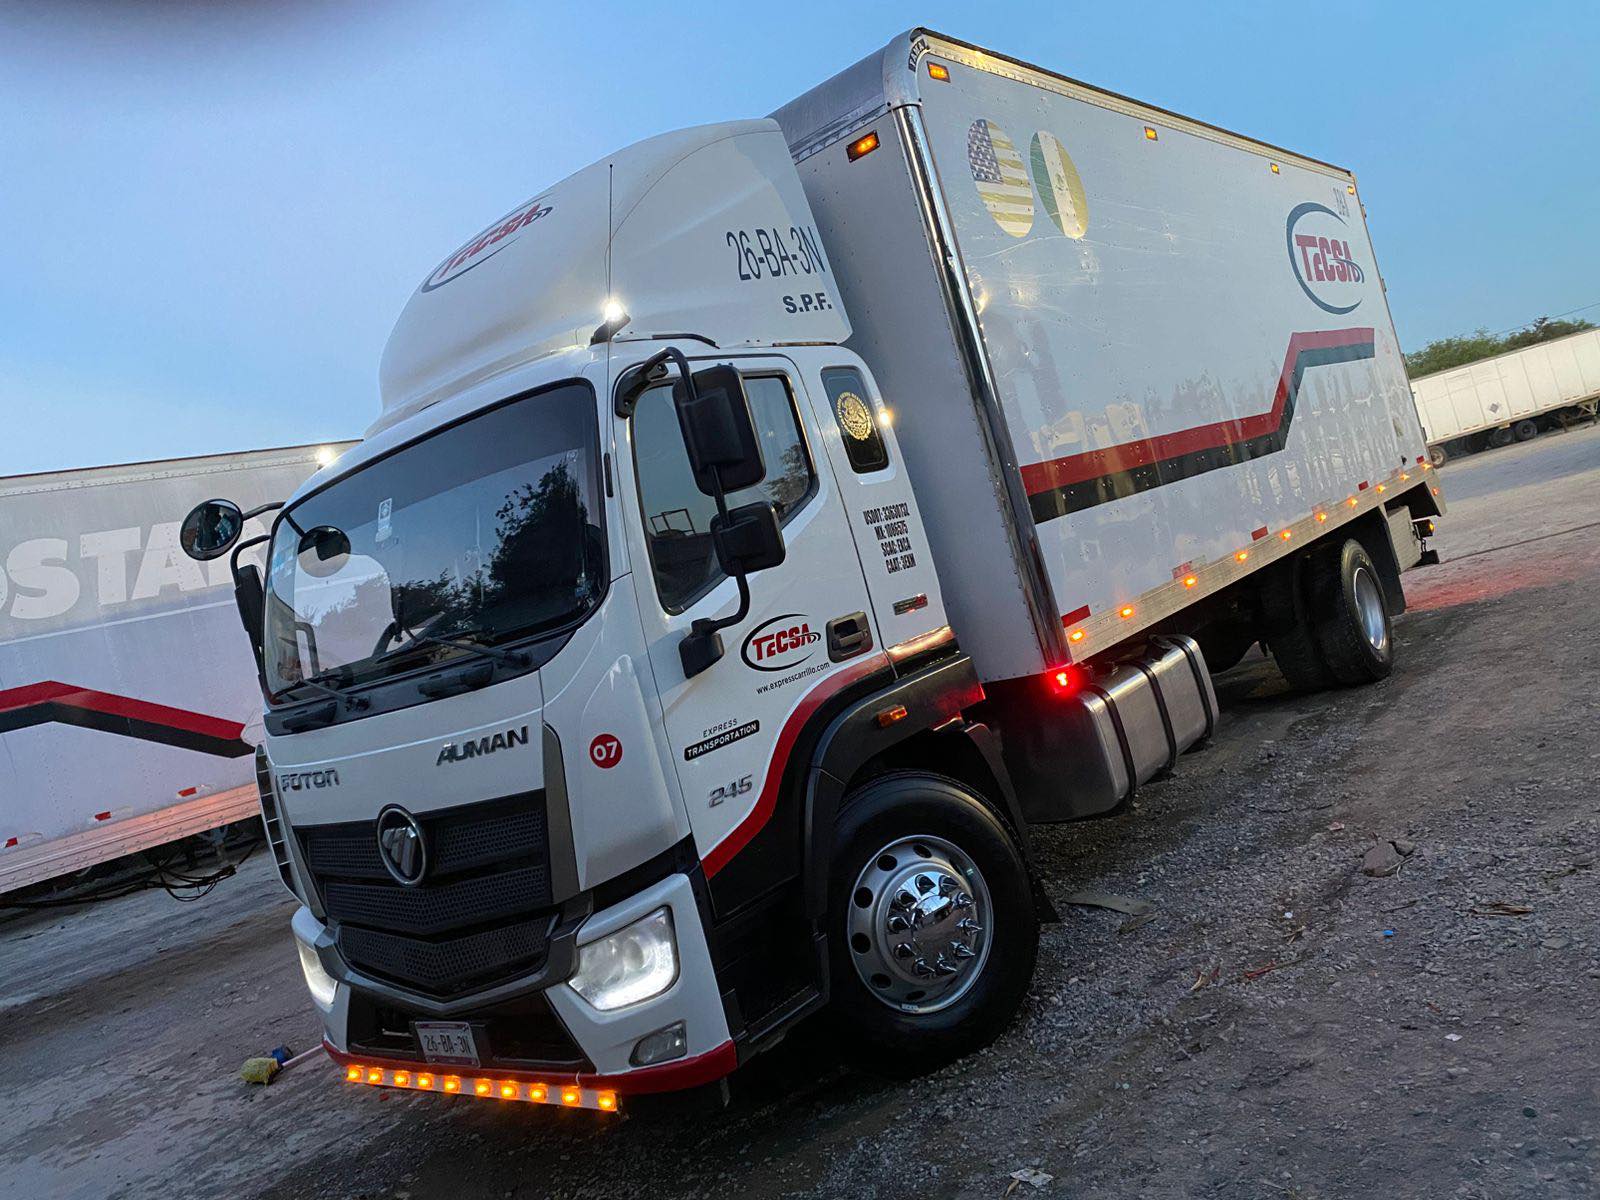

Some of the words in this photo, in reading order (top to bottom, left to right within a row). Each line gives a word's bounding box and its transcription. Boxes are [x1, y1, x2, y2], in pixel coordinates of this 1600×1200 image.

[726, 226, 825, 280] 26-BA-3N
[782, 292, 832, 314] S.P.F.
[687, 722, 757, 758] TRANSPORTATION
[703, 718, 738, 738] EXPRESS
[436, 725, 529, 767] AUMAN
[593, 741, 618, 761] 07
[281, 768, 340, 792] FOTON
[708, 774, 753, 809] 245
